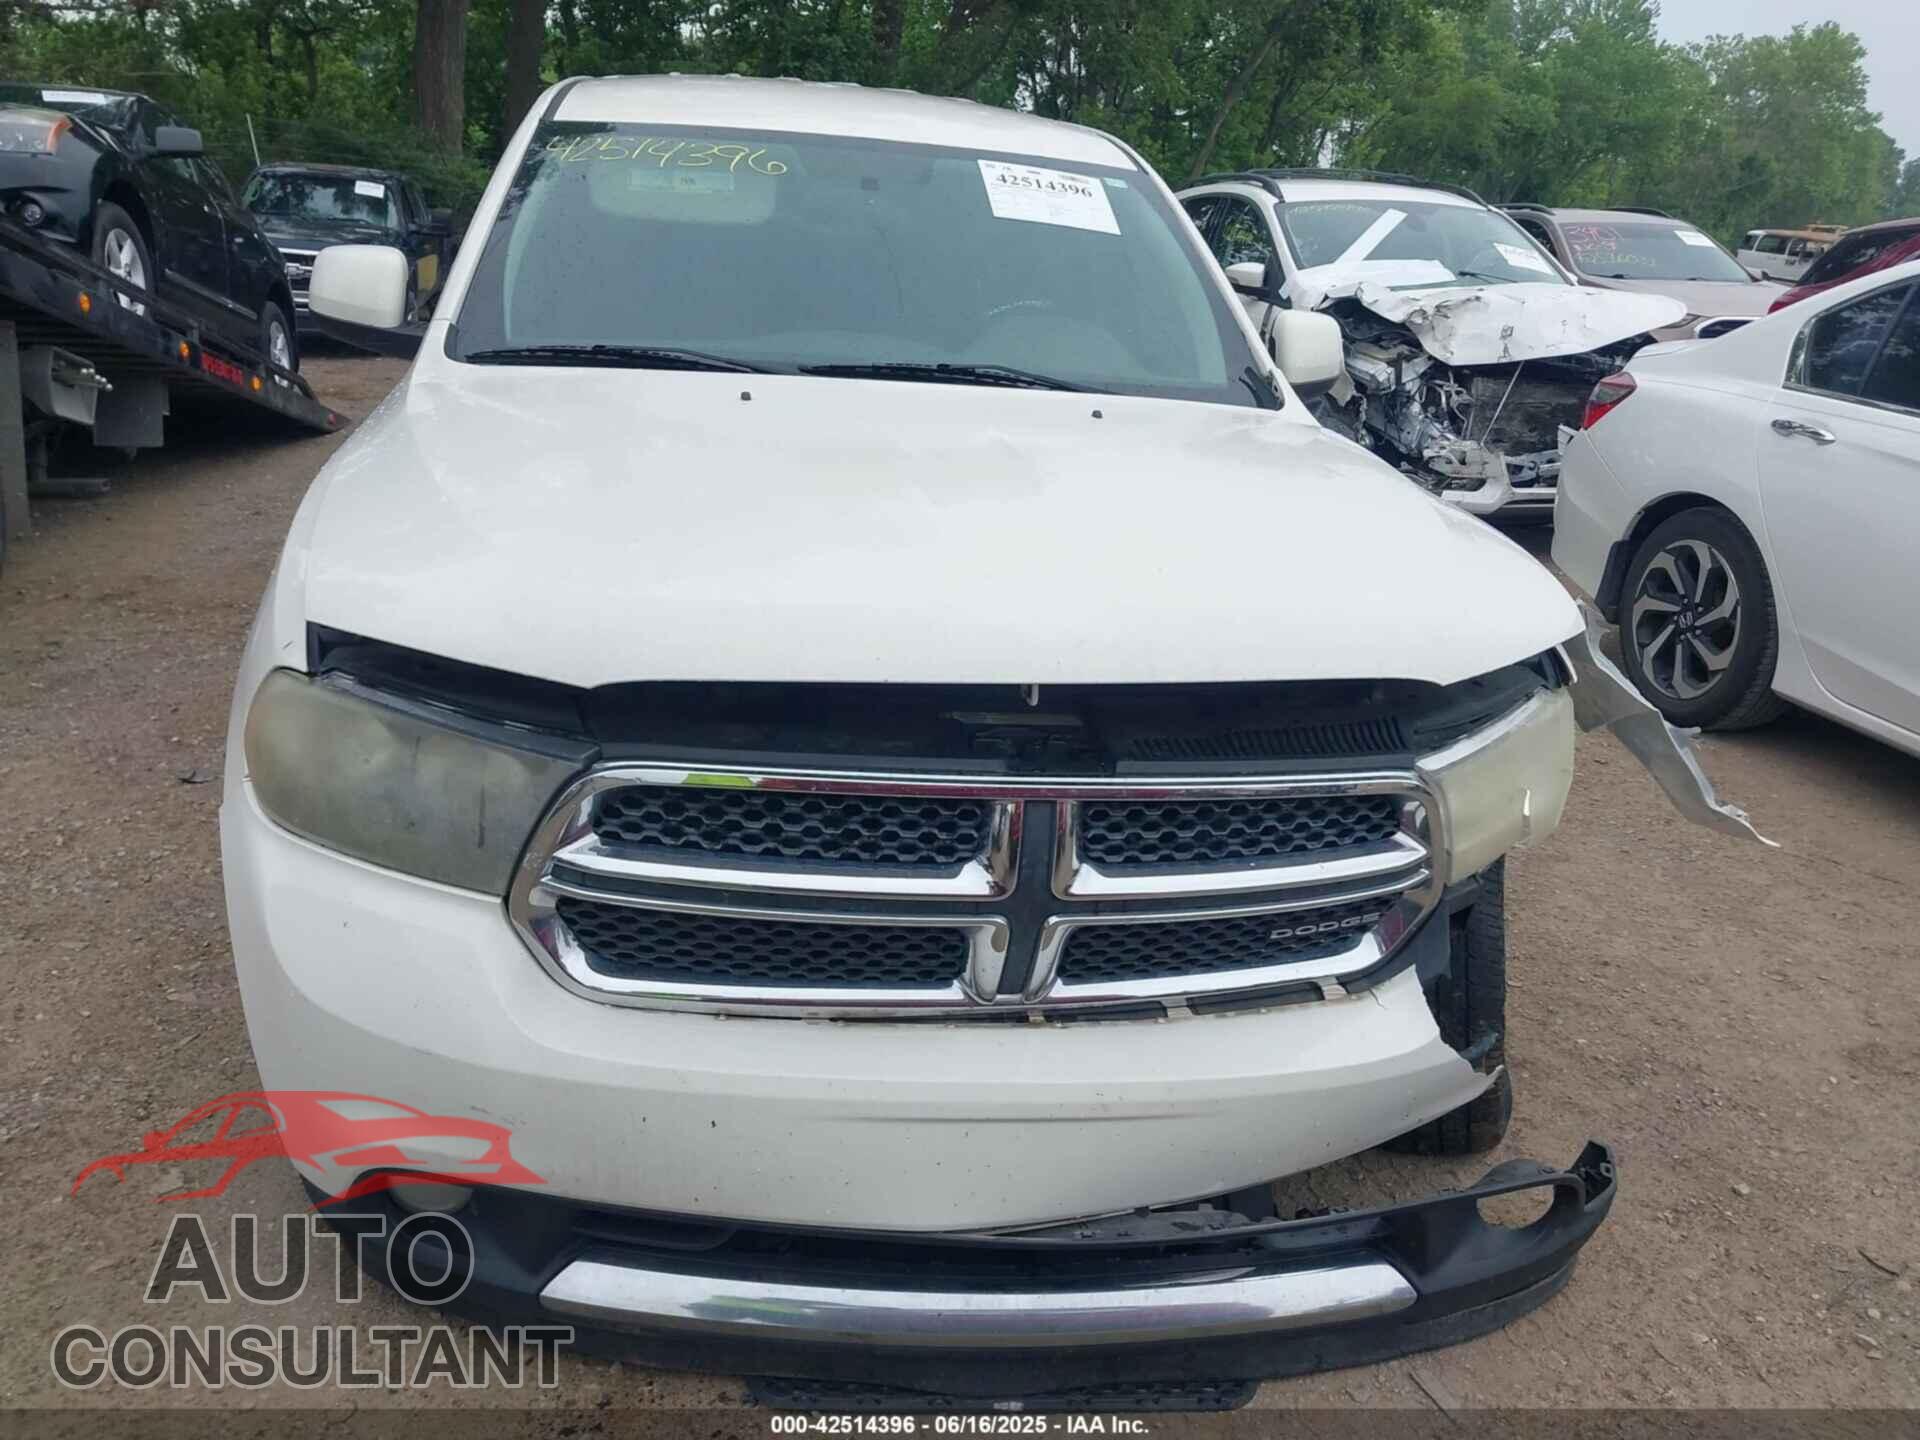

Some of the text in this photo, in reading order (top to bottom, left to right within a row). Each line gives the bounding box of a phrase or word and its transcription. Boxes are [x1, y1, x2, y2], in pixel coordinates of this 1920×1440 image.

[546, 135, 787, 175] 42514396
[995, 173, 1094, 198] 42514396
[1270, 912, 1382, 939] DODGE
